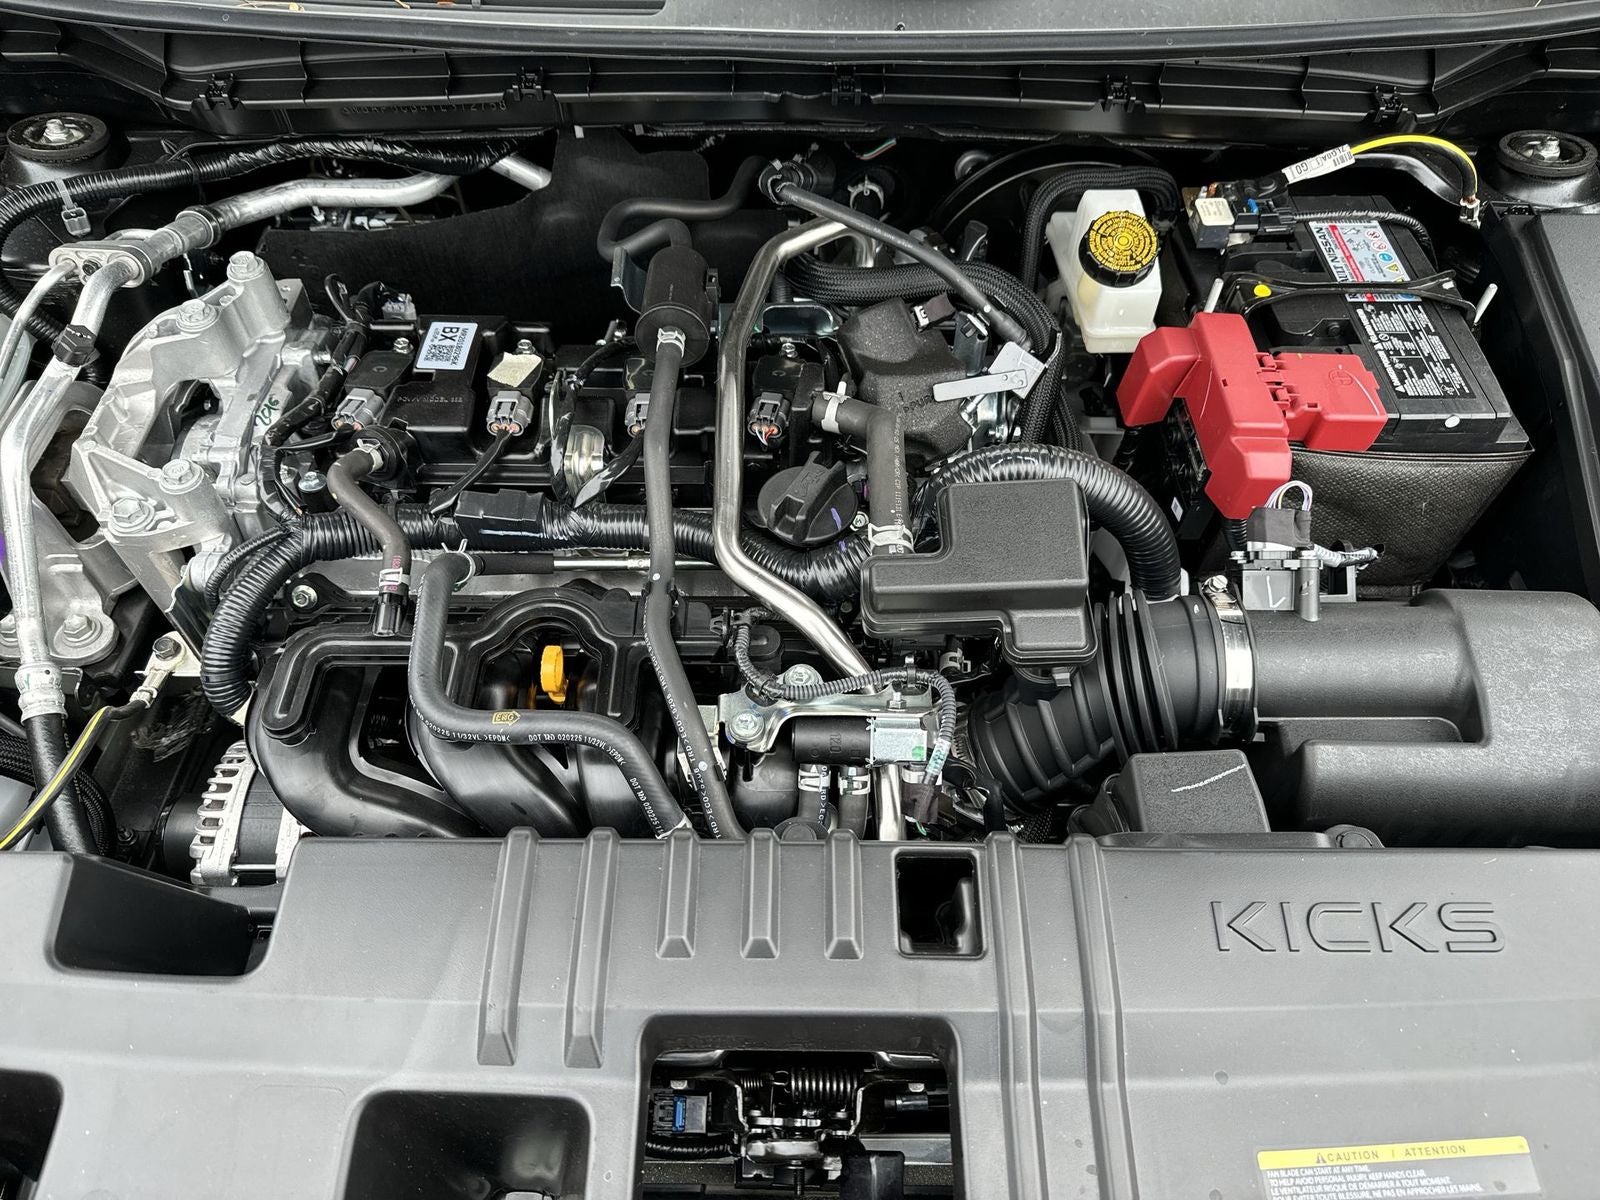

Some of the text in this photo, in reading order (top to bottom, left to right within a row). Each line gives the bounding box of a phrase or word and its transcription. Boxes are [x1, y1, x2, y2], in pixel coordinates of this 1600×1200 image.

[1315, 227, 1340, 263] NISSAN
[438, 327, 460, 342] BX
[557, 733, 583, 742] 020225
[1210, 901, 1505, 952] KICKS
[1327, 1151, 1379, 1162] CAUTION
[1404, 1145, 1467, 1157] ATTENTION
[1267, 1170, 1279, 1178] FAN
[1280, 1168, 1299, 1177] BLADE
[1300, 1168, 1314, 1176] CAN
[1314, 1167, 1332, 1175] START
[1341, 1165, 1354, 1173] ANY
[1269, 1178, 1279, 1186] TO
[1279, 1177, 1294, 1186] HELP
[1295, 1176, 1314, 1185] AVOID
[1315, 1174, 1345, 1184] PERSONAL
[1369, 1172, 1383, 1180] KEEP
[1383, 1170, 1405, 1179] HANDS
[1279, 1184, 1323, 1195] VENTILATEUR
[1324, 1182, 1348, 1192] RISQUE
[1349, 1181, 1358, 1189] DE
[1401, 1179, 1419, 1188] TOUT
[1316, 1192, 1337, 1200] TOUTE
[1373, 1189, 1382, 1198] NE
[1383, 1189, 1396, 1197] PAS
[1397, 1188, 1406, 1196] EN
[1406, 1186, 1446, 1196] APPROCHER
[1446, 1185, 1459, 1194] LES
